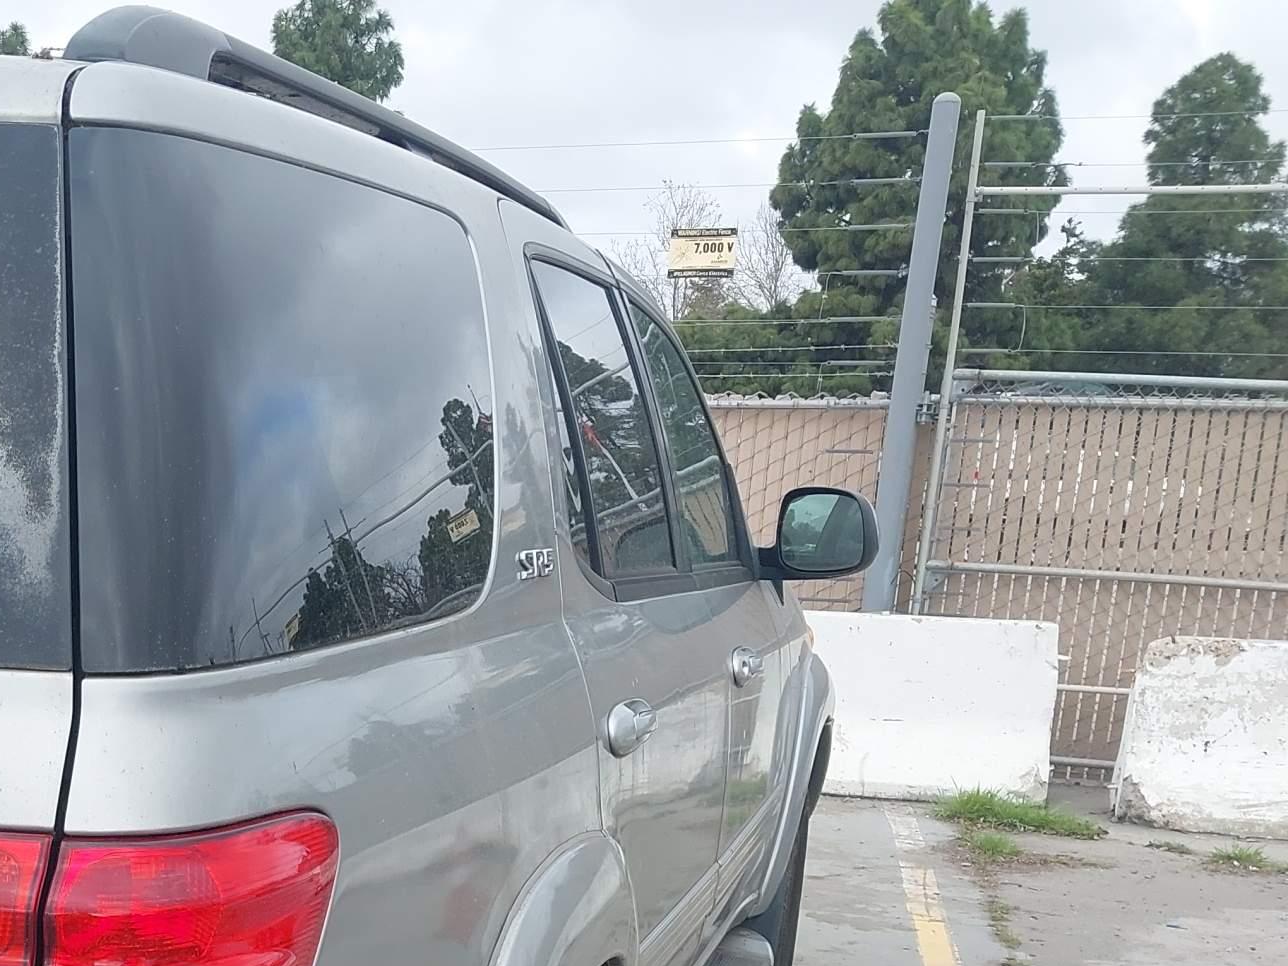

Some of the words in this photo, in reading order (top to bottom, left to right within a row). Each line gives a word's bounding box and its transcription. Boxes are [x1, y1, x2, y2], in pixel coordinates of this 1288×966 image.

[694, 242, 724, 255] 7,000
[727, 241, 734, 253] V
[515, 548, 554, 580] SR5
